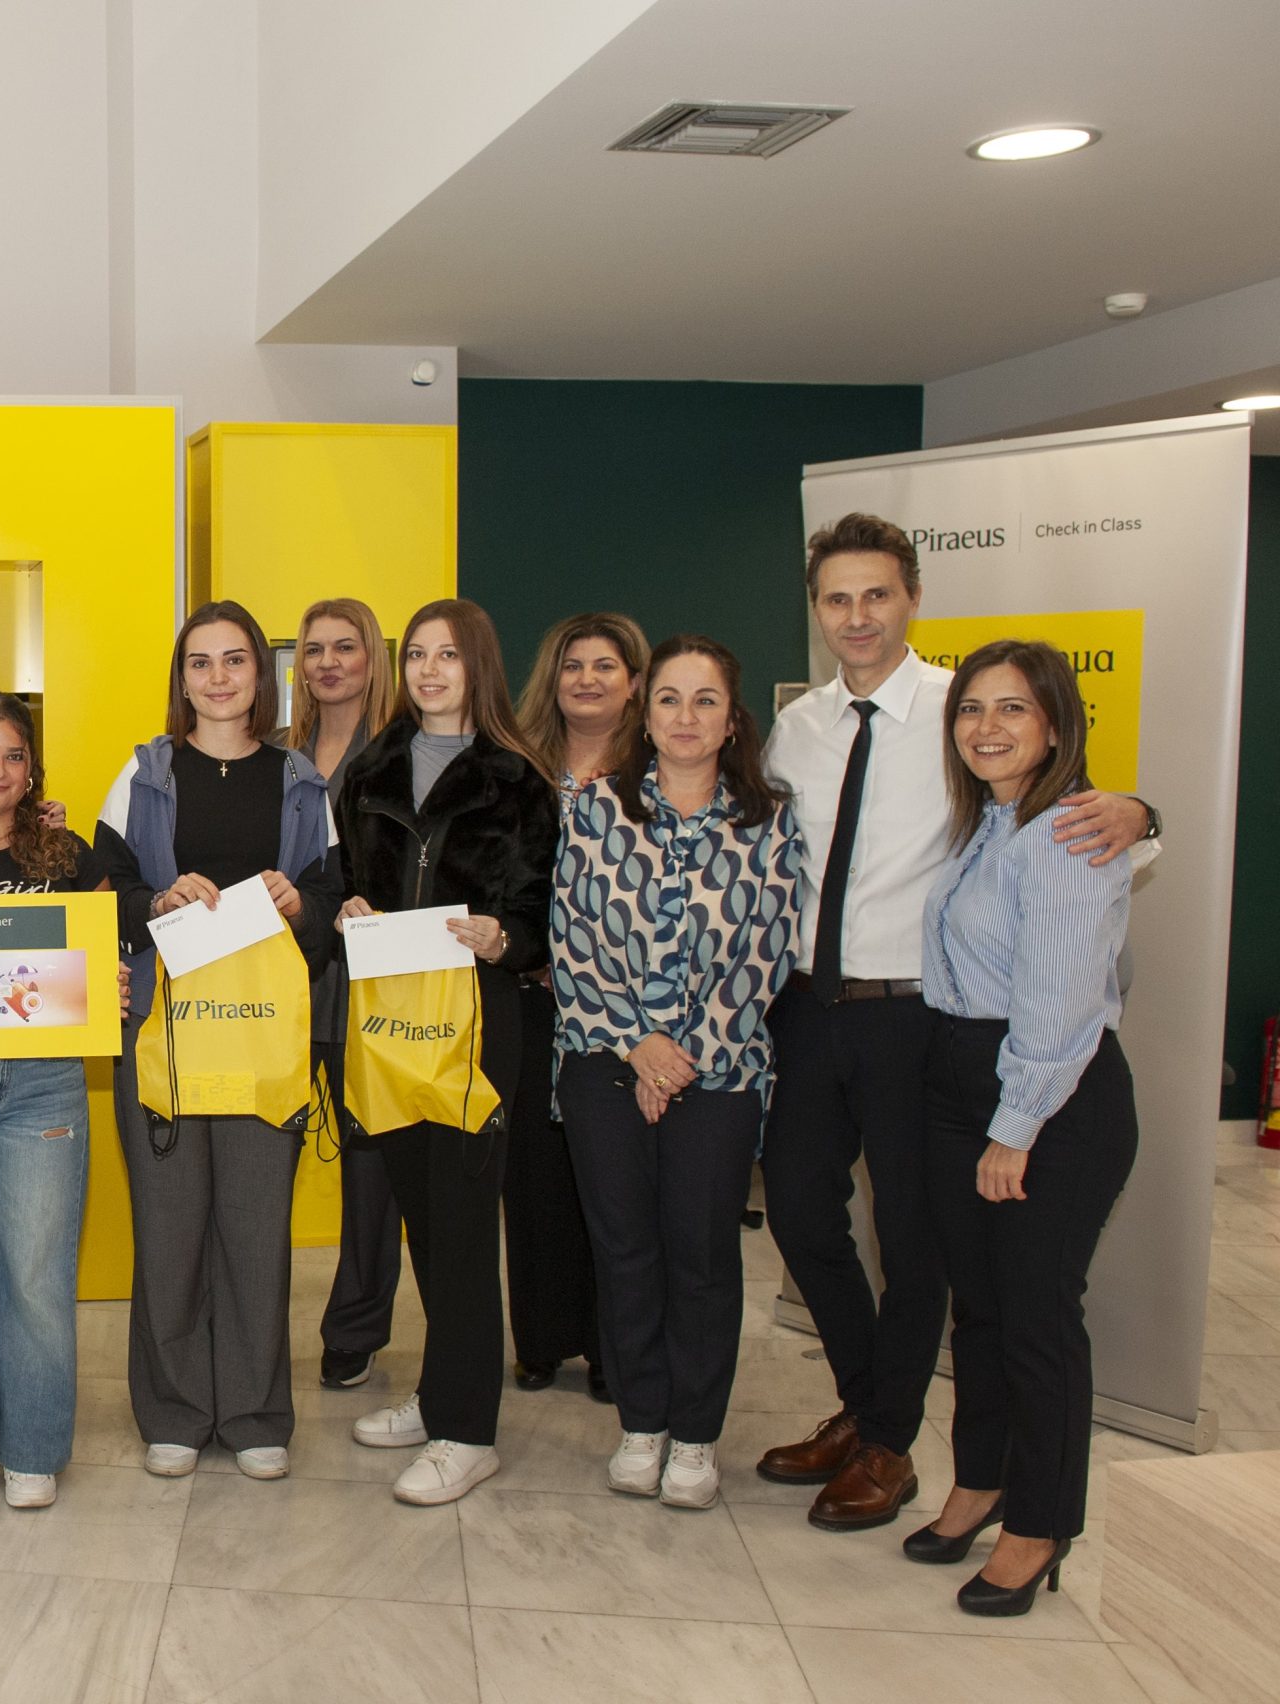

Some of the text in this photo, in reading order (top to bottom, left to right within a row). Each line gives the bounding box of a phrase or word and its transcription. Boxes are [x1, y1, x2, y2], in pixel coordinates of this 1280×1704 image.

[1035, 517, 1142, 538] Check in Class
[911, 527, 1005, 552] Piraeus
[195, 999, 275, 1020] Piraeus
[388, 1019, 456, 1041] Piraeus
